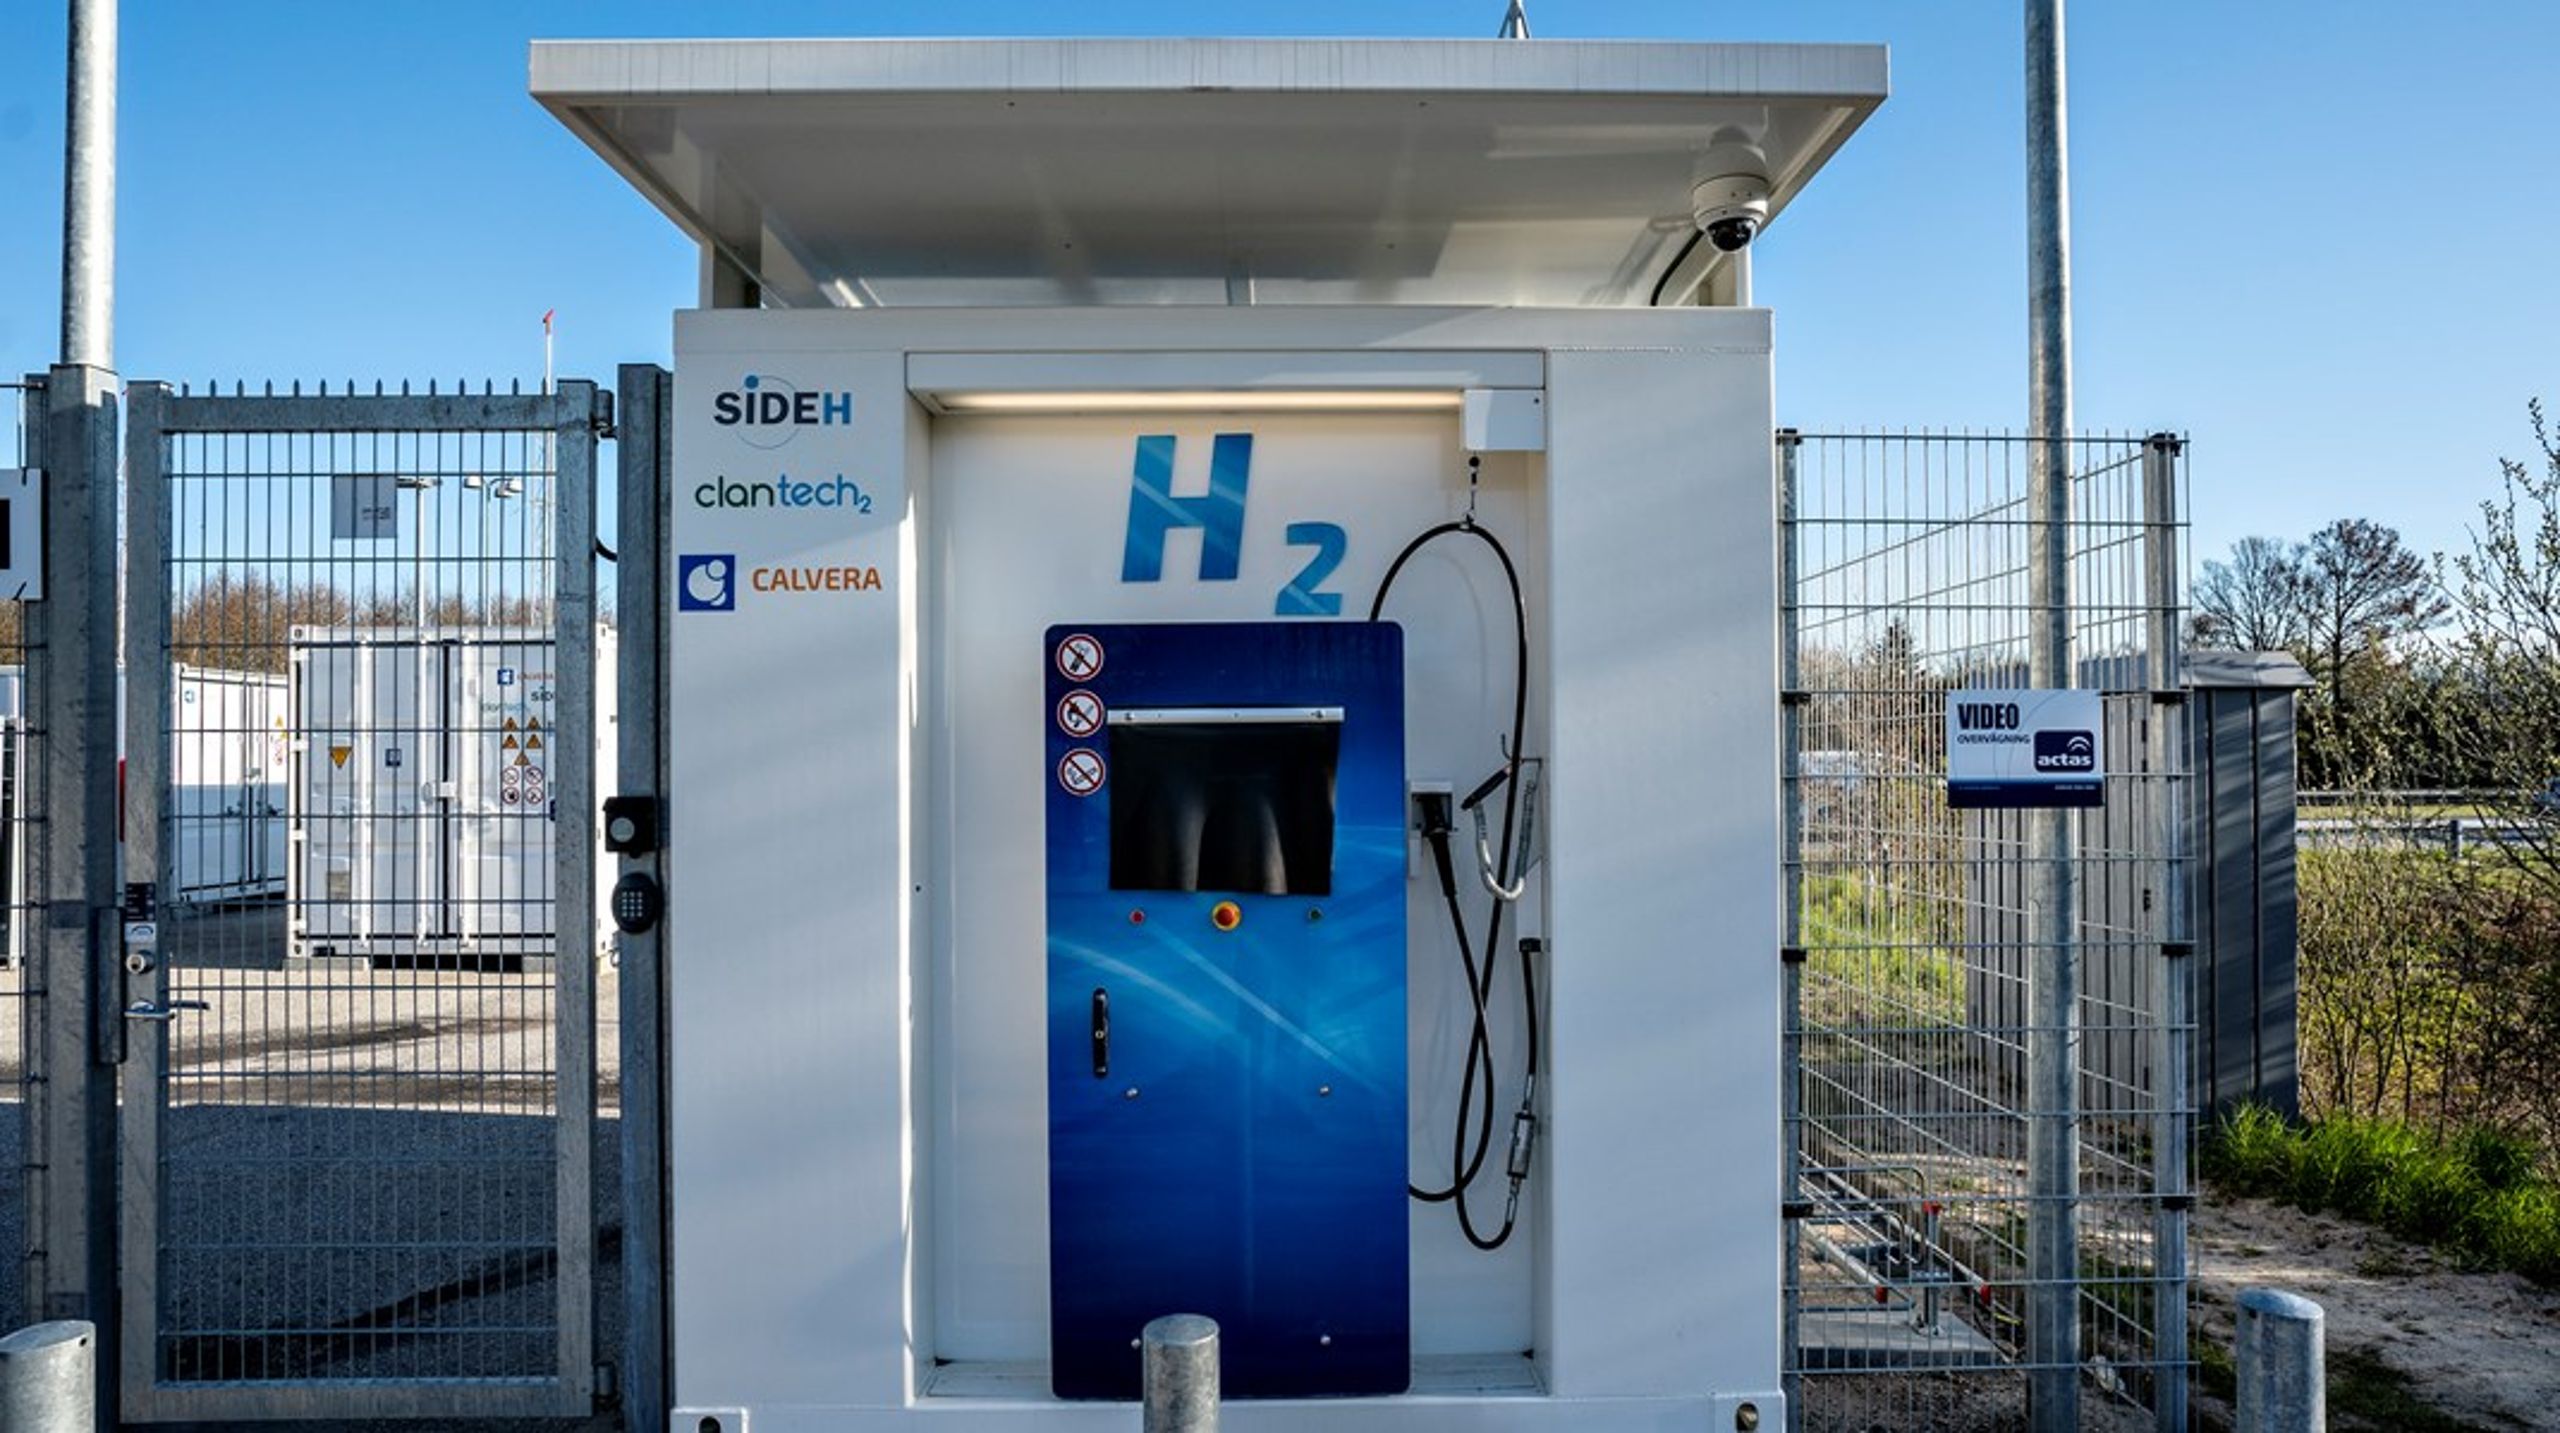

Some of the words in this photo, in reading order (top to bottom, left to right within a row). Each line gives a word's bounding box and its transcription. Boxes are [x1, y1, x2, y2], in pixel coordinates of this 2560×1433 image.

[752, 568, 882, 591] CALVERA
[1957, 703, 2019, 730] VIDEO
[2038, 753, 2092, 766] actas
